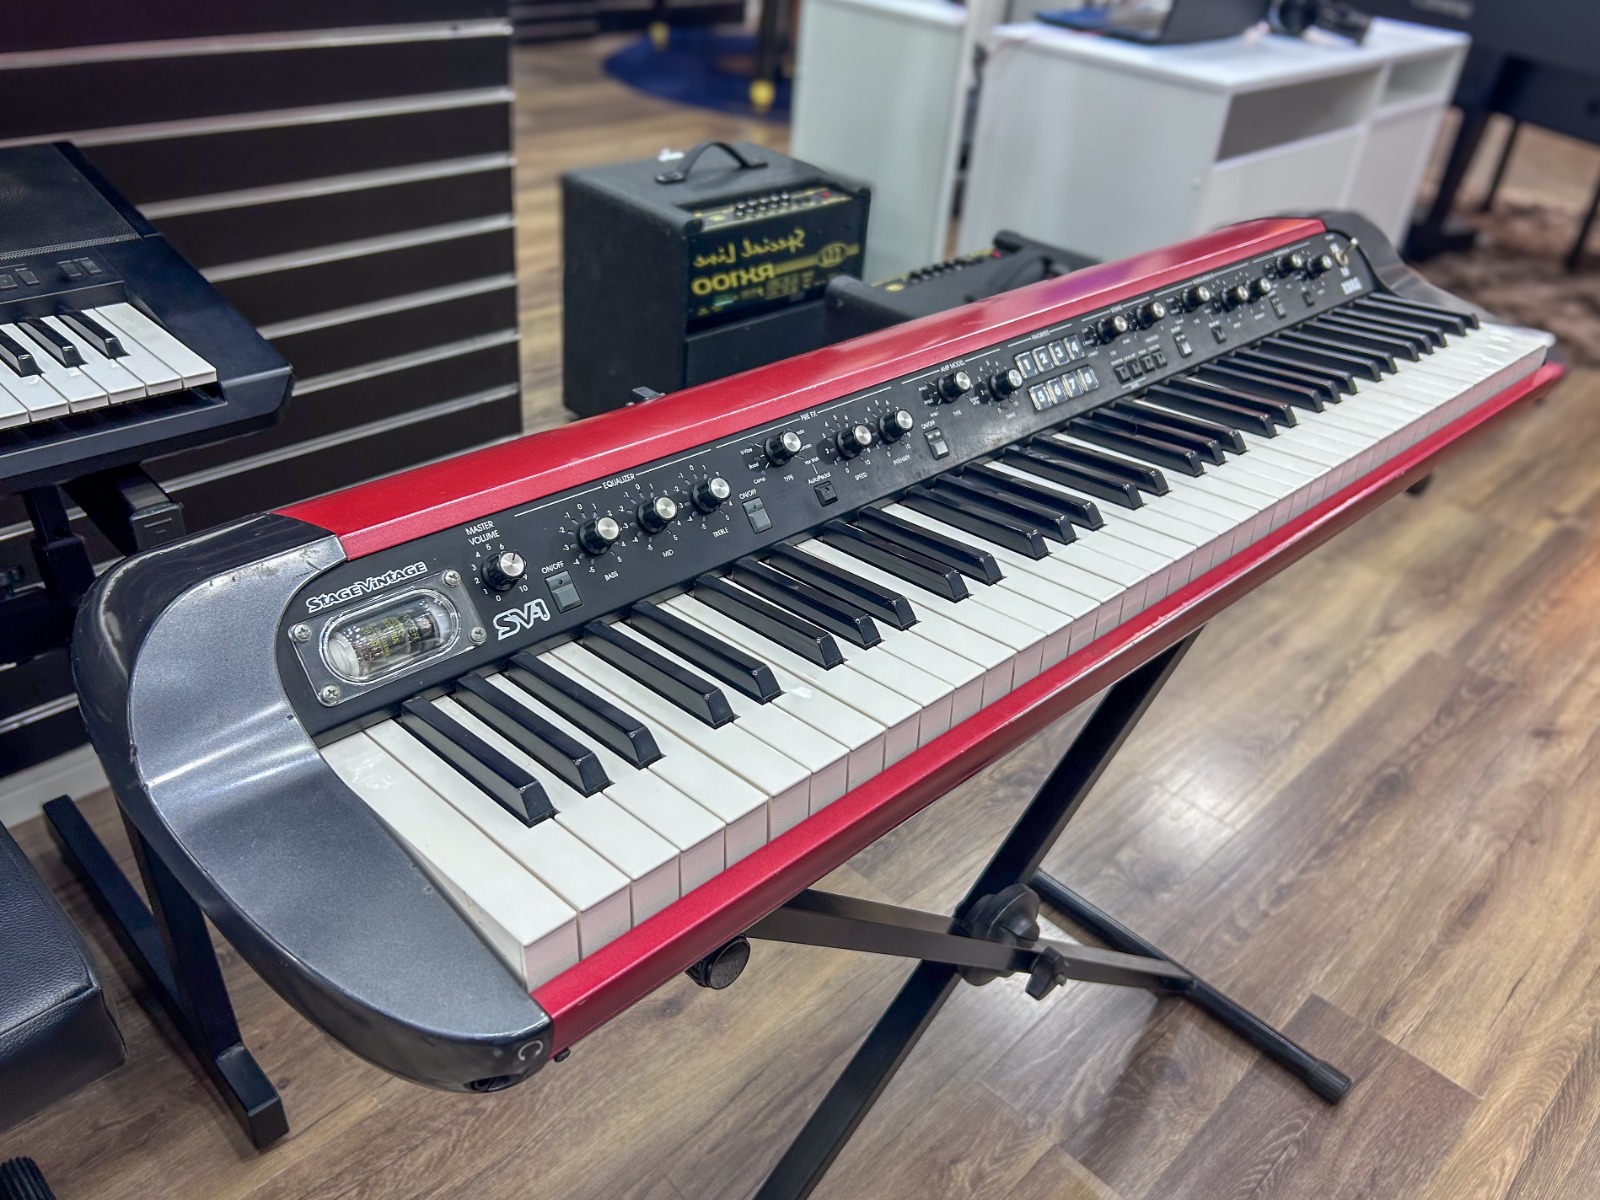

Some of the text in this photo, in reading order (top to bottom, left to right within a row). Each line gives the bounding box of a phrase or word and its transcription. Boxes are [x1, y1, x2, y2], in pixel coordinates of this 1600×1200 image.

[1054, 346, 1064, 358] 3
[1071, 341, 1080, 353] 4
[1023, 358, 1031, 370] 1
[1039, 352, 1048, 364] 2
[1068, 378, 1075, 390] 7
[1084, 372, 1093, 384] 8
[1037, 390, 1046, 402] 5
[1054, 384, 1062, 396] 6
[602, 472, 636, 490] EQUALIZER
[738, 488, 757, 500] ON/OFF
[465, 520, 494, 536] MASTER
[712, 526, 730, 538] TREBLE
[468, 529, 500, 545] VOLUME
[485, 543, 492, 551] 5
[662, 549, 674, 558] MID
[471, 563, 477, 571] 3
[541, 560, 565, 574] ON/OFF
[474, 577, 480, 585] 2
[604, 570, 619, 581] BASS
[518, 584, 529, 593] 10
[495, 594, 502, 602] 0
